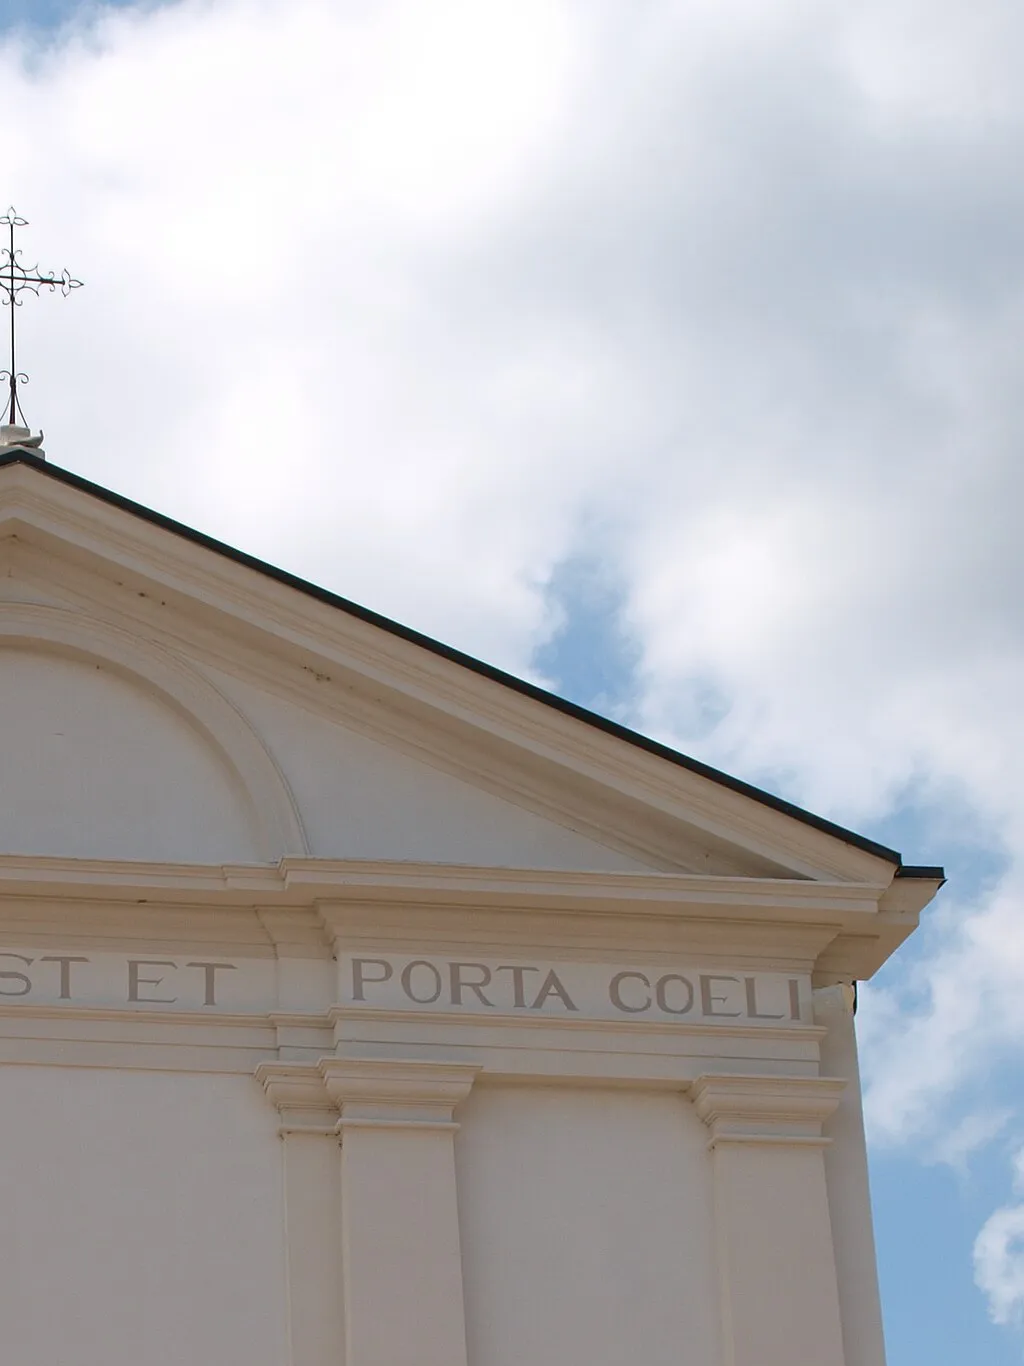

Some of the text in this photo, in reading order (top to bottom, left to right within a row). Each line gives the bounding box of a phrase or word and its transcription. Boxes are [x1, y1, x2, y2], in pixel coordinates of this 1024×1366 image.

[128, 959, 238, 1006] ET
[350, 957, 579, 1012] PORTA
[609, 971, 801, 1021] COELI
